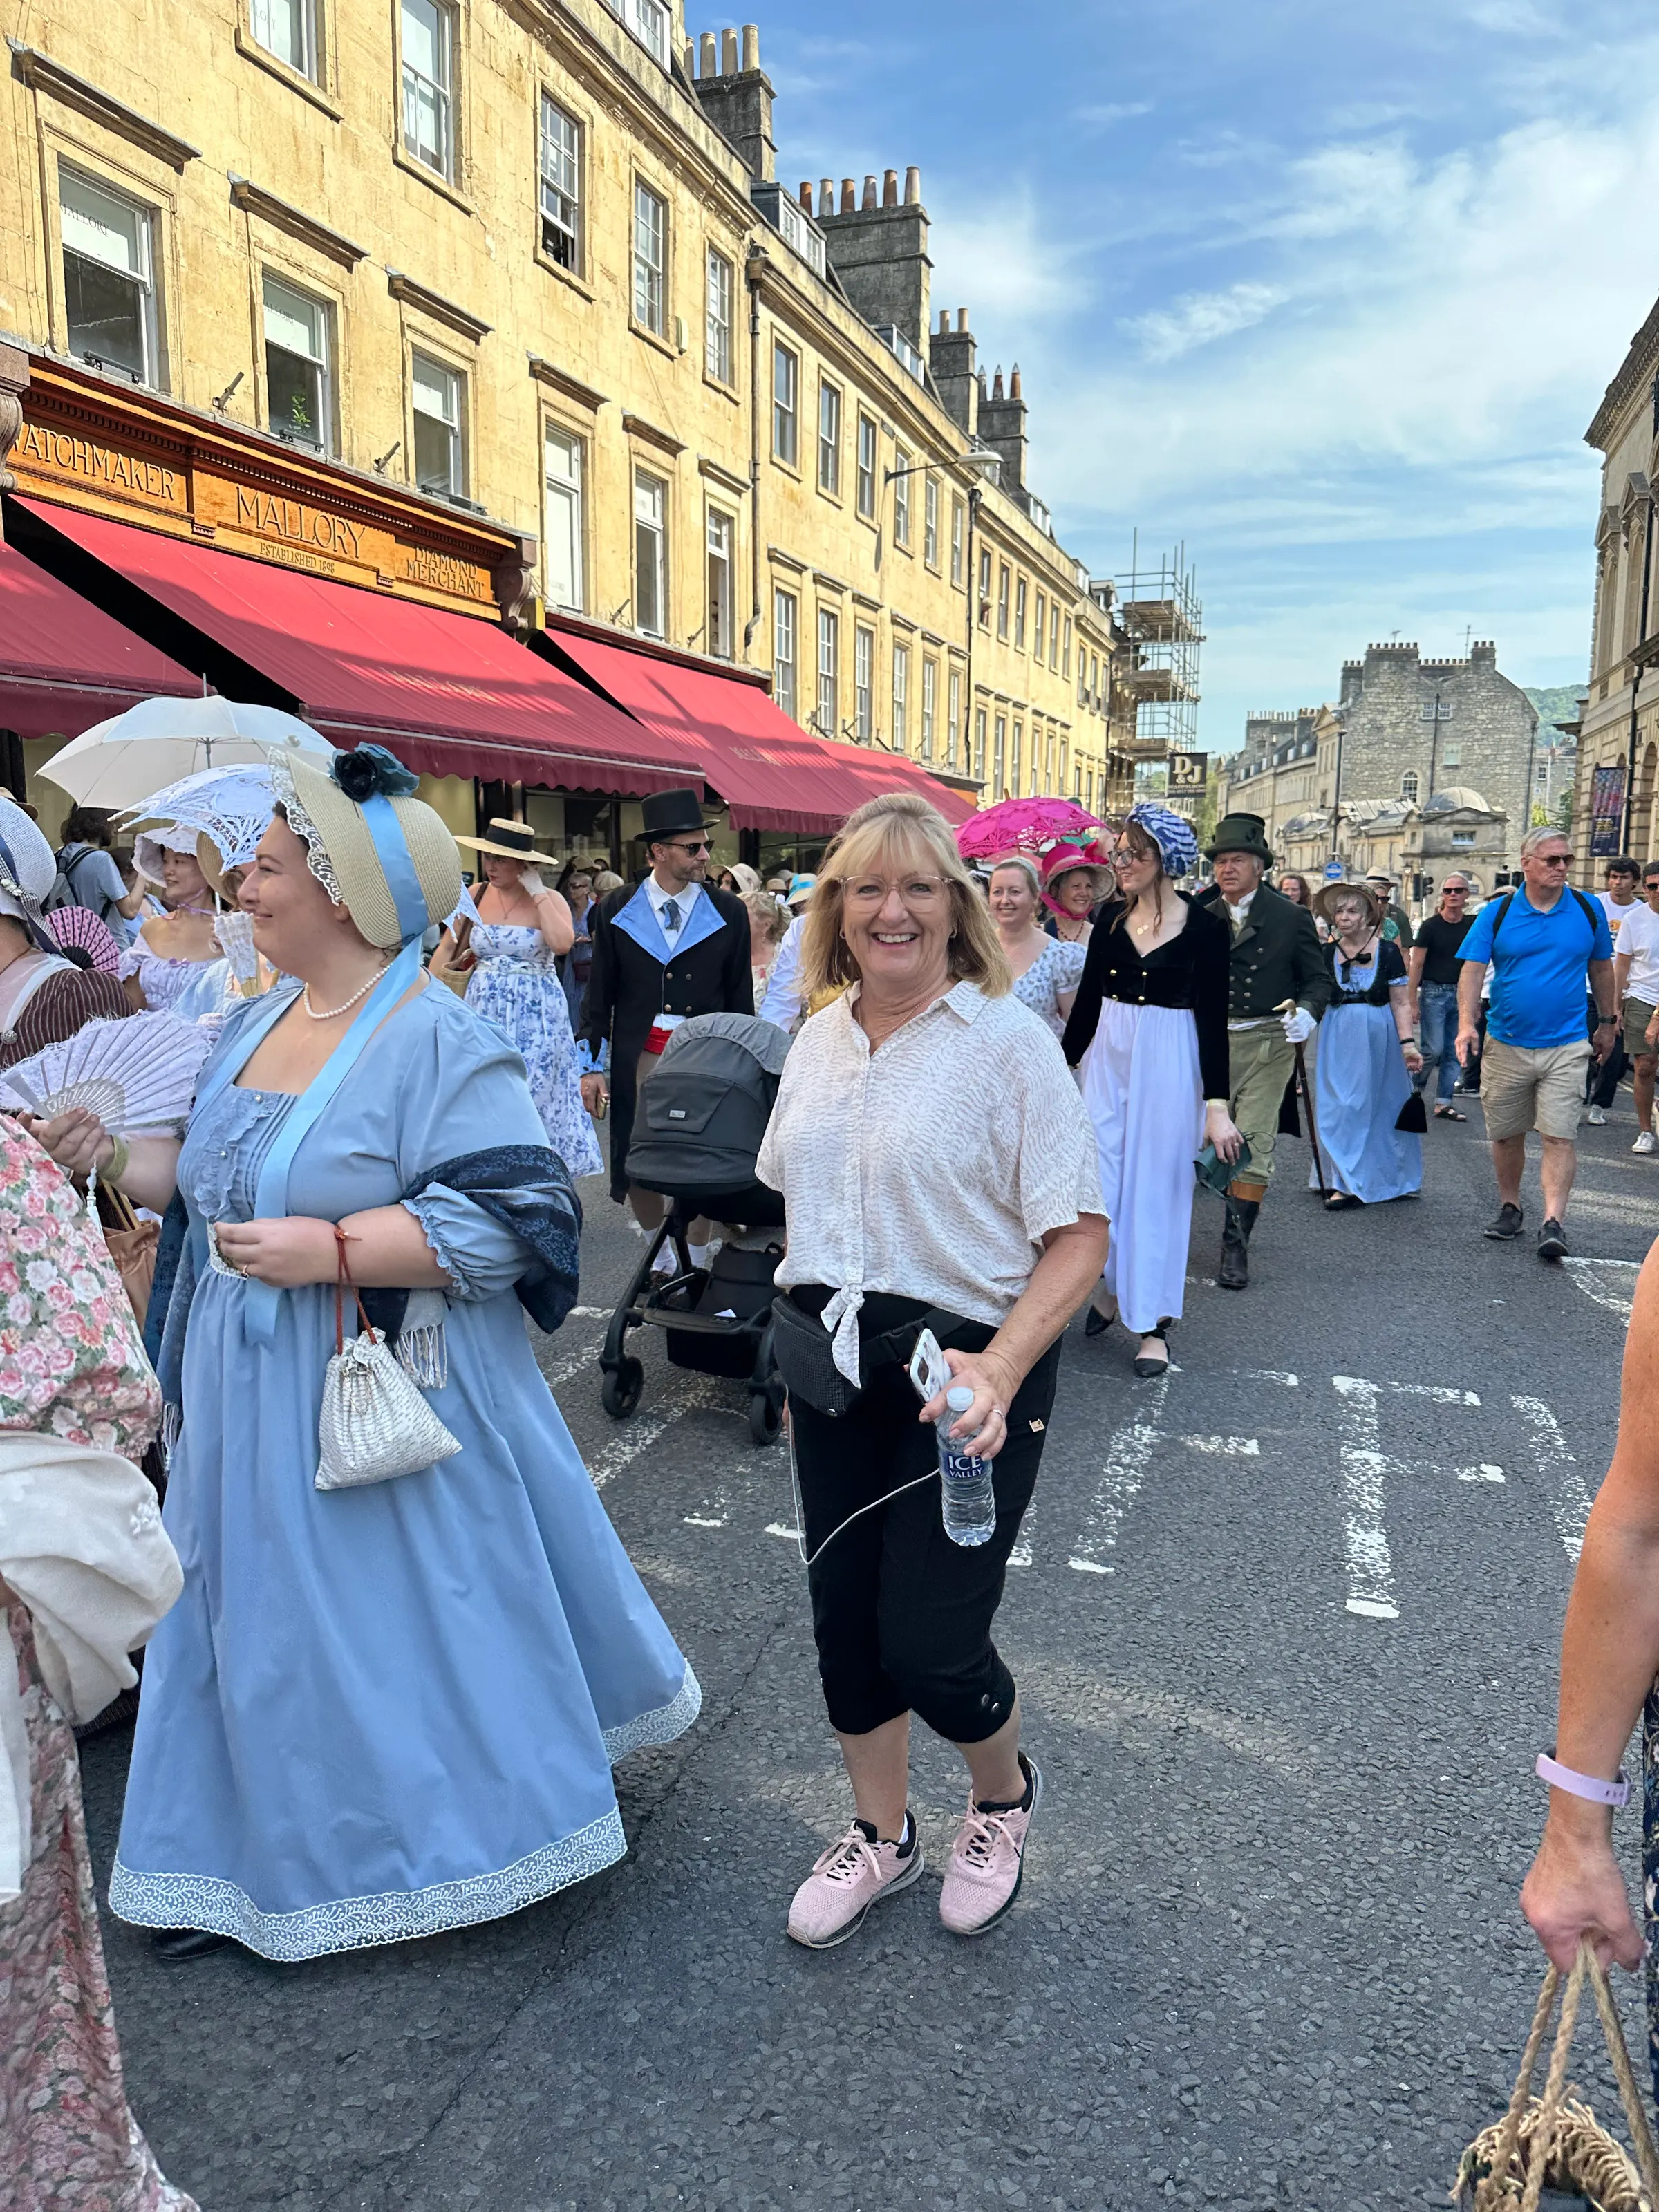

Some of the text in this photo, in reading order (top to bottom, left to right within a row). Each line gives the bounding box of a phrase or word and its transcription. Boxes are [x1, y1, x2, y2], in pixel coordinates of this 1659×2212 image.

[236, 485, 366, 559] MALLORY
[259, 542, 317, 569] ESTABLISHED
[415, 547, 478, 579] DIAMOND
[406, 559, 485, 598] MERCHANT
[948, 1454, 982, 1470] ICE
[949, 1468, 983, 1479] VALLEY
